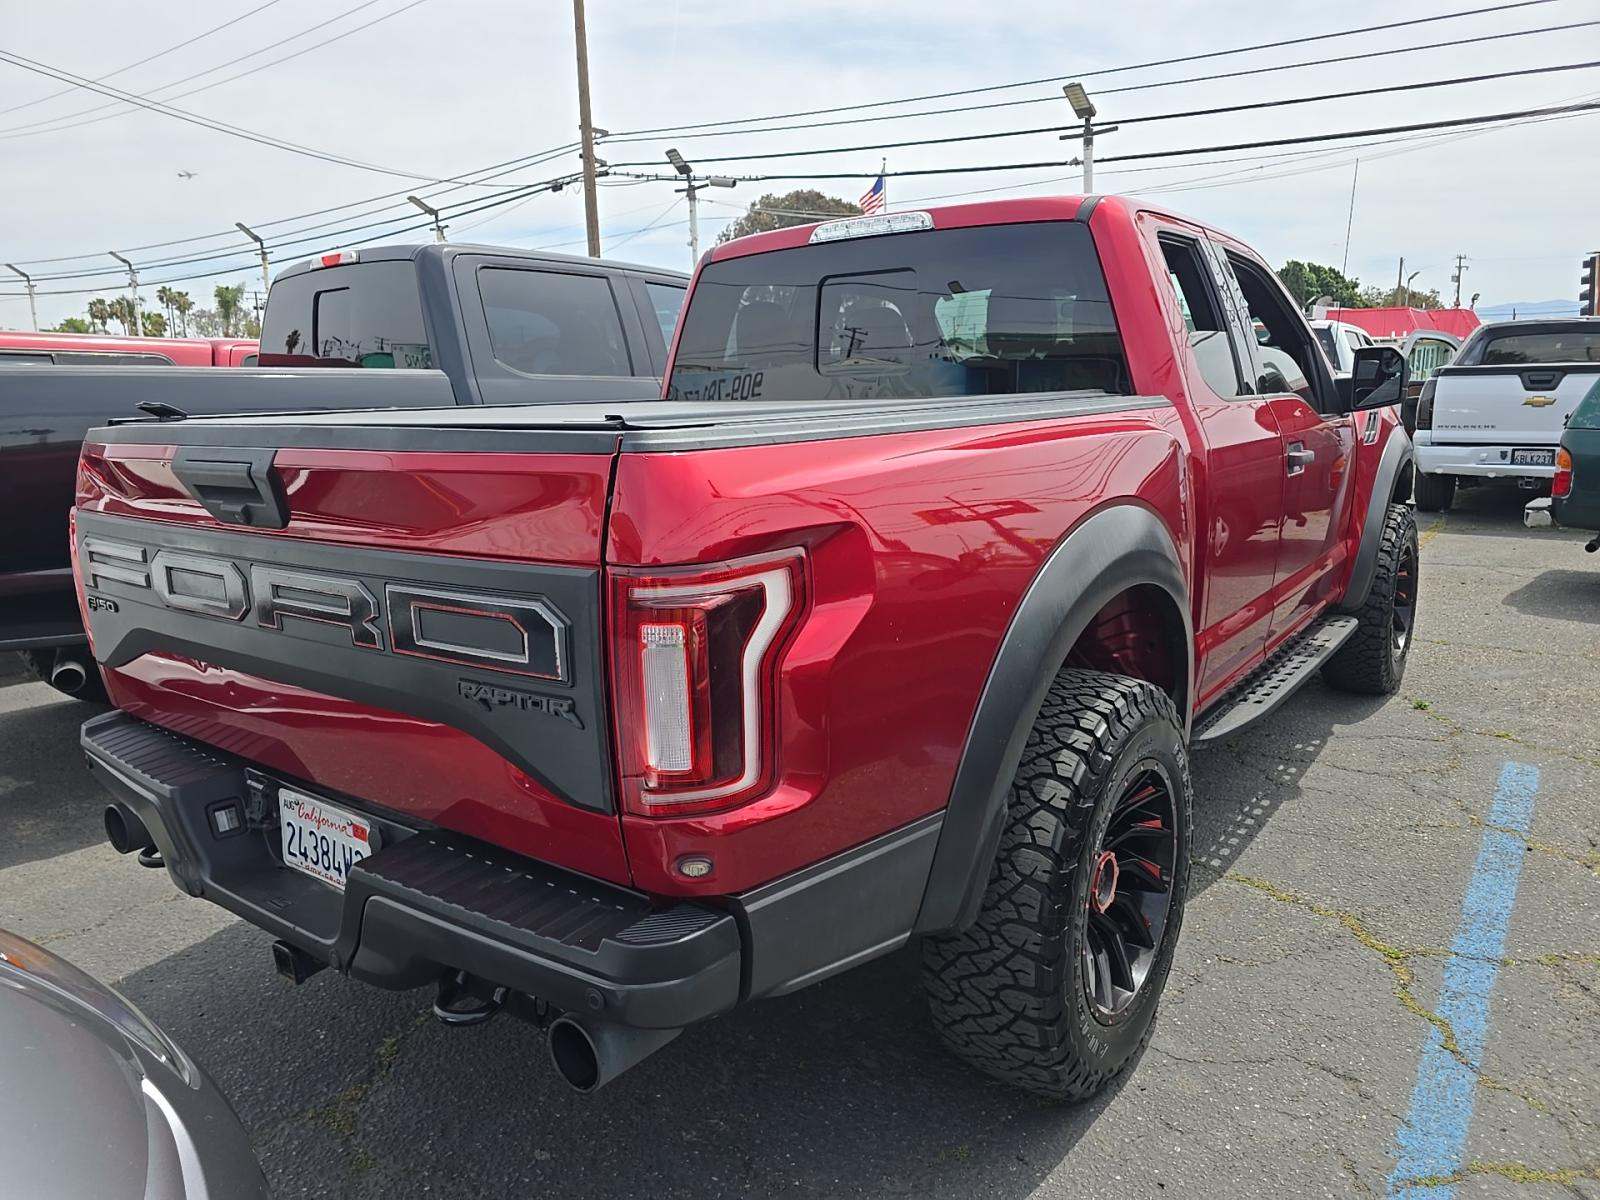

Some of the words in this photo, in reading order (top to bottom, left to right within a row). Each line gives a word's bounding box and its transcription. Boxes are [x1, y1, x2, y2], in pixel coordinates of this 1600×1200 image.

[1514, 454, 1553, 465] 6BLK237
[80, 536, 572, 684] FORD
[458, 677, 585, 730] RAPTOR
[298, 802, 347, 830] California
